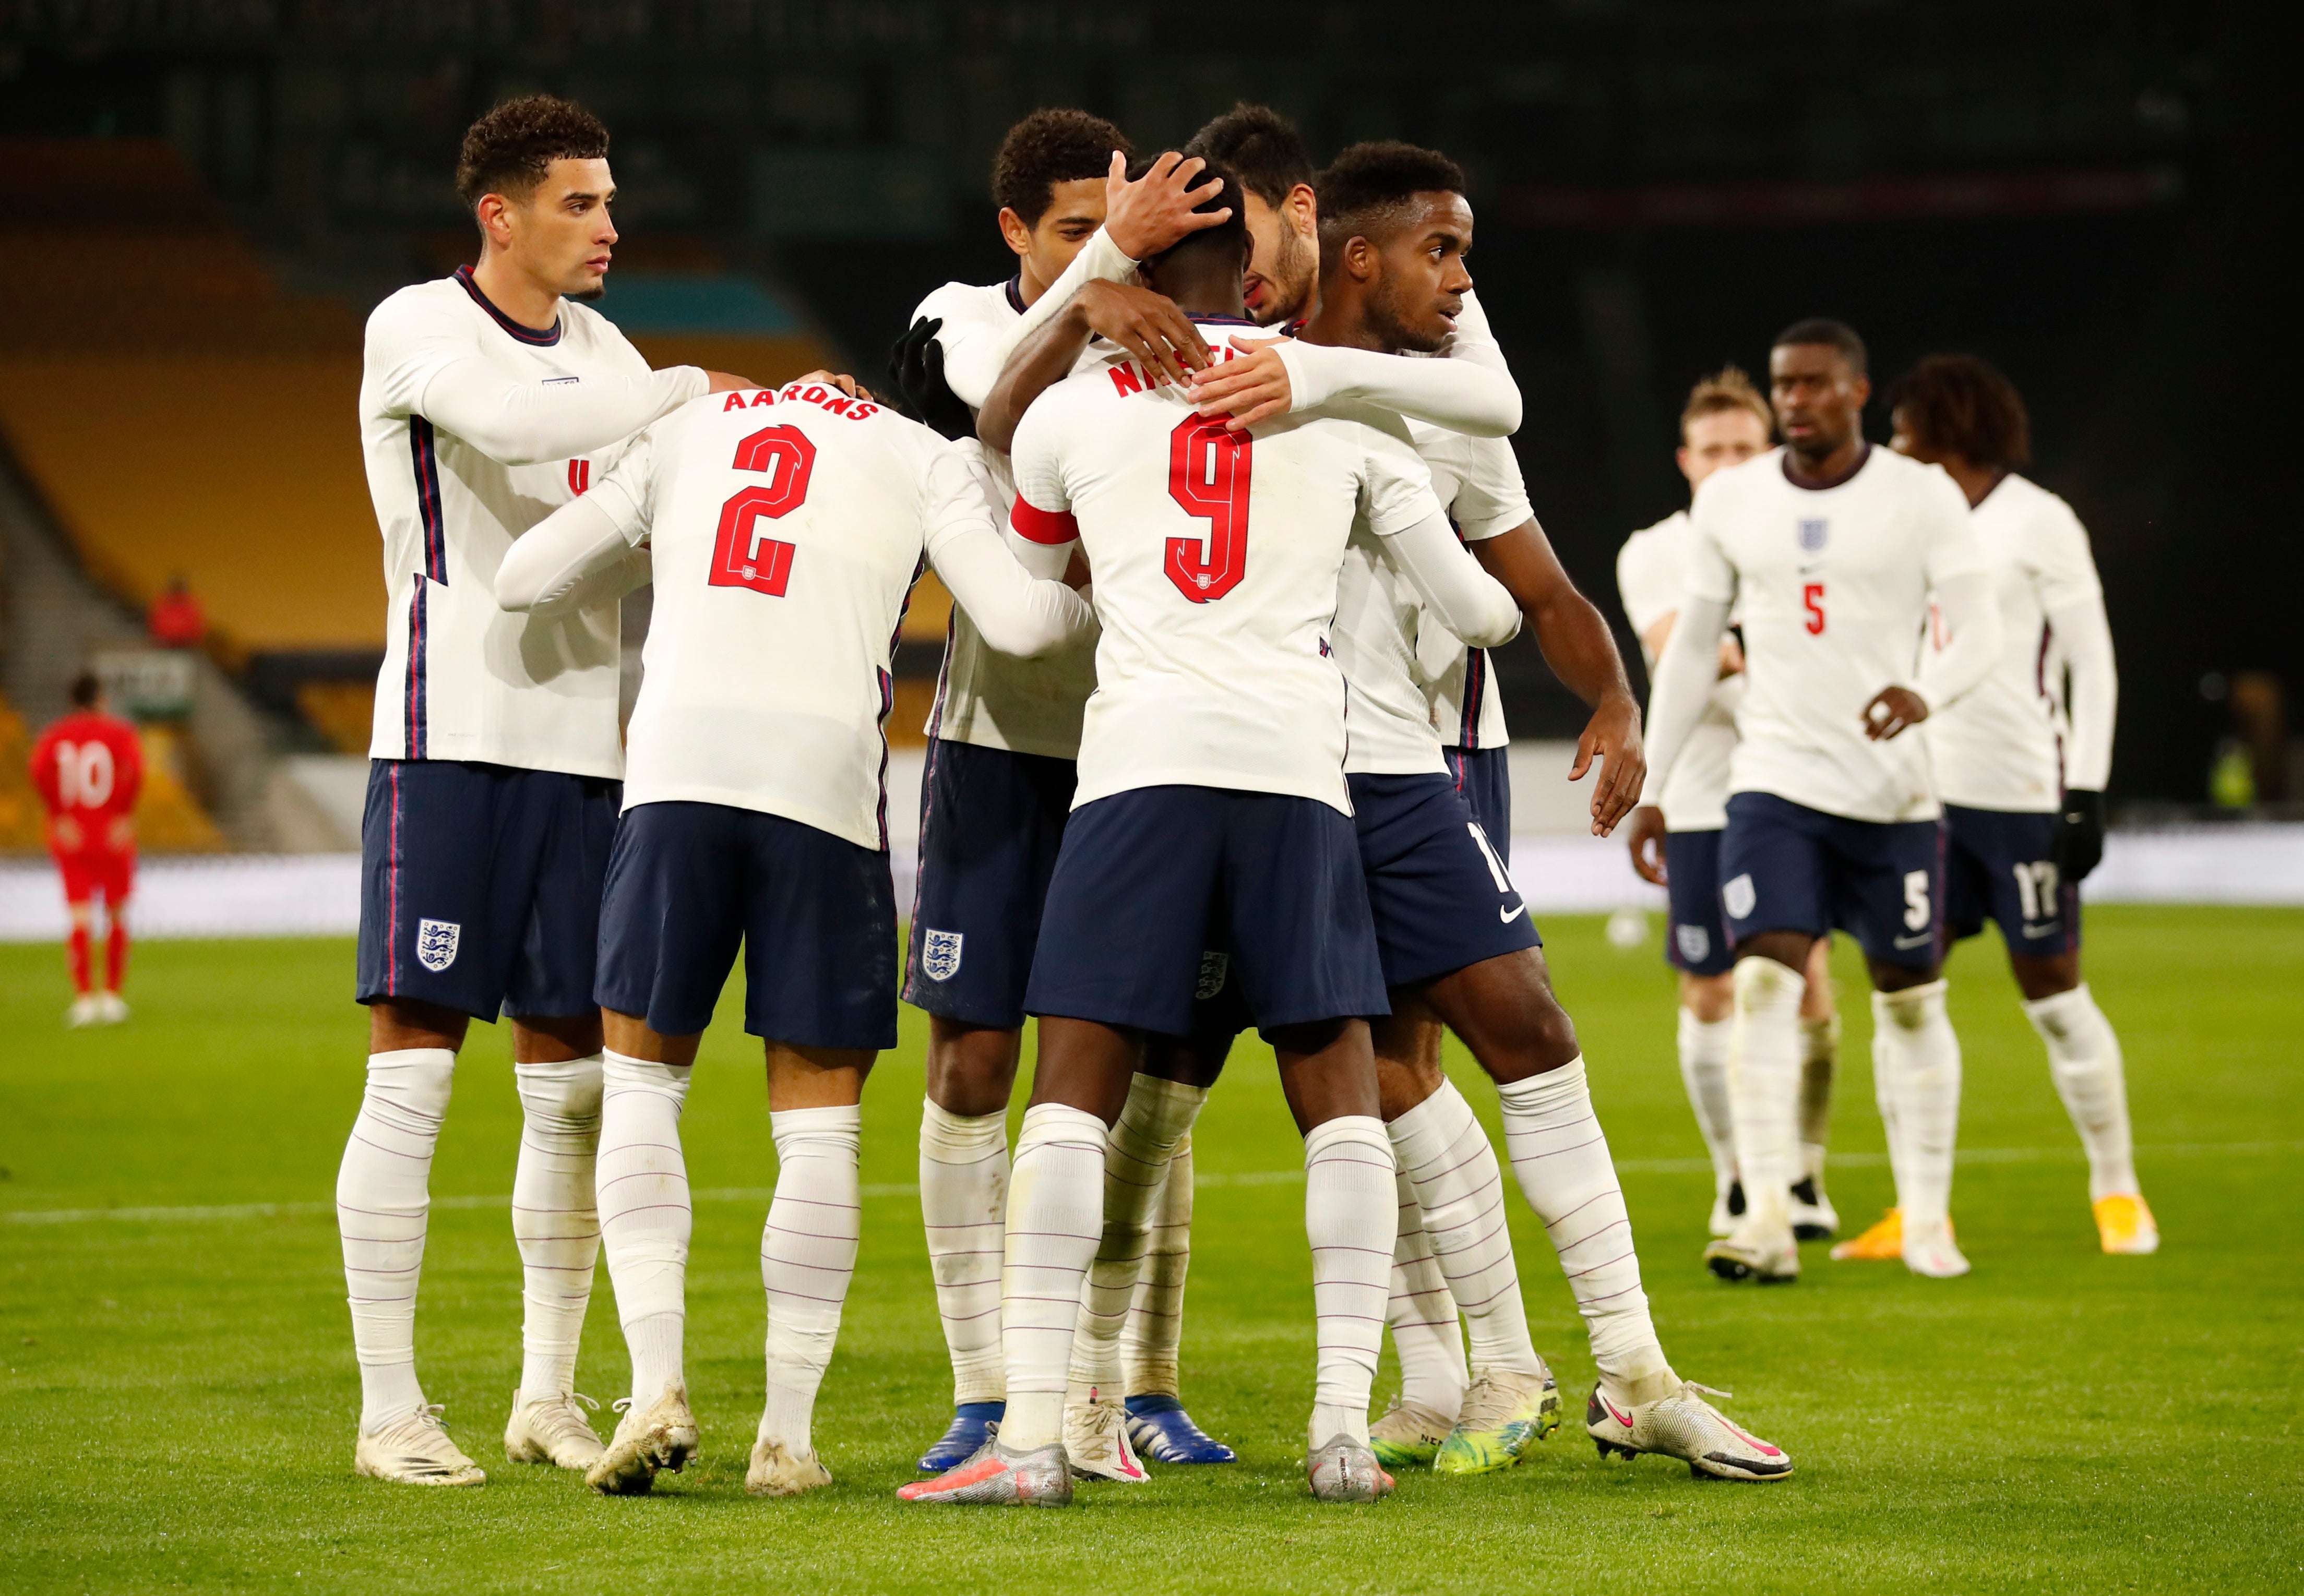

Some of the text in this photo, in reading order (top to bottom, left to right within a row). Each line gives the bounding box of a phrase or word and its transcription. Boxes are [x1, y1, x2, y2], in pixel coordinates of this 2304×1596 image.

[723, 384, 878, 420] AARONS
[708, 424, 817, 597] 2
[1164, 411, 1252, 604] 9
[1804, 583, 1825, 635] 5
[55, 739, 114, 809] 10
[1904, 869, 1930, 931] 5
[2013, 860, 2059, 920] 17
